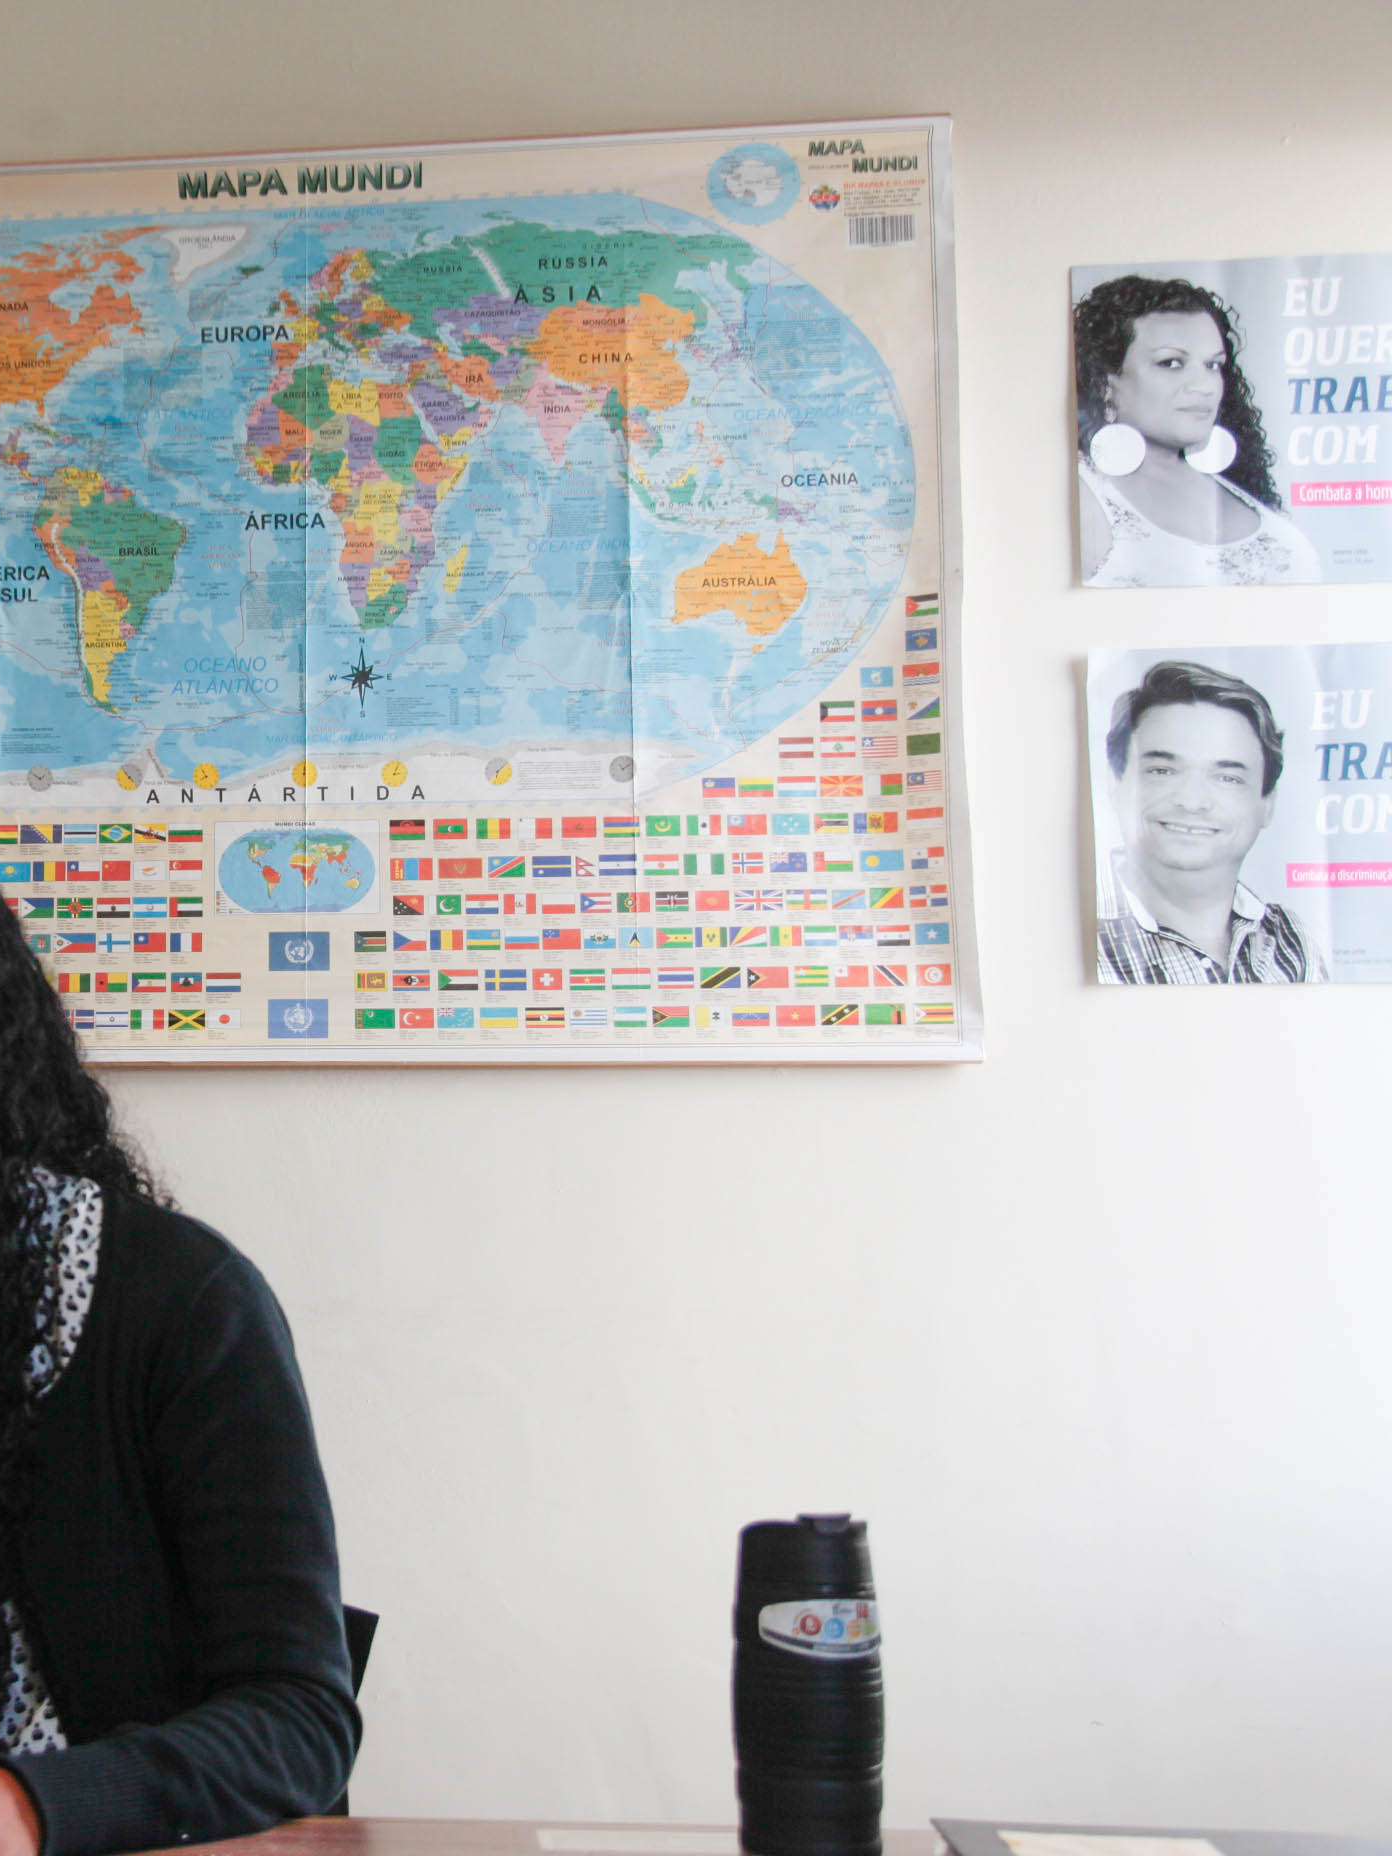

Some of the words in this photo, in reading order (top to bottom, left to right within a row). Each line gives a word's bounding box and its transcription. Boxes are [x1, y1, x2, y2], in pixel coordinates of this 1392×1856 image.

[808, 139, 865, 156] MAPA
[852, 156, 918, 173] MUNDI
[177, 168, 287, 200] MAPA
[297, 161, 423, 194] MUNDI
[1282, 276, 1342, 318] EU
[200, 324, 290, 344] EUROPA
[578, 353, 634, 365] CHINA
[465, 373, 484, 385] IRÃ
[378, 390, 404, 401] EGITO
[285, 427, 305, 437] MALI
[1288, 424, 1380, 466] COM
[781, 471, 858, 488] OCEANIA
[1299, 484, 1352, 502] Combata
[1354, 488, 1363, 500] a
[244, 511, 326, 531] ÁFRICA
[118, 545, 161, 558] BRASIL
[702, 574, 777, 588] AUSTRÁLIA
[1, 586, 39, 603] SUL
[85, 640, 127, 649] ARGENTINA
[358, 637, 366, 645] N
[183, 656, 267, 674] OCEANO
[386, 673, 393, 681] E
[171, 676, 279, 696] ATLÂNTICO
[359, 710, 366, 718] S
[1311, 689, 1374, 731] EU
[146, 782, 426, 804] ANTÁRTIDA
[1292, 869, 1329, 882] Combata
[1330, 871, 1337, 881] a
